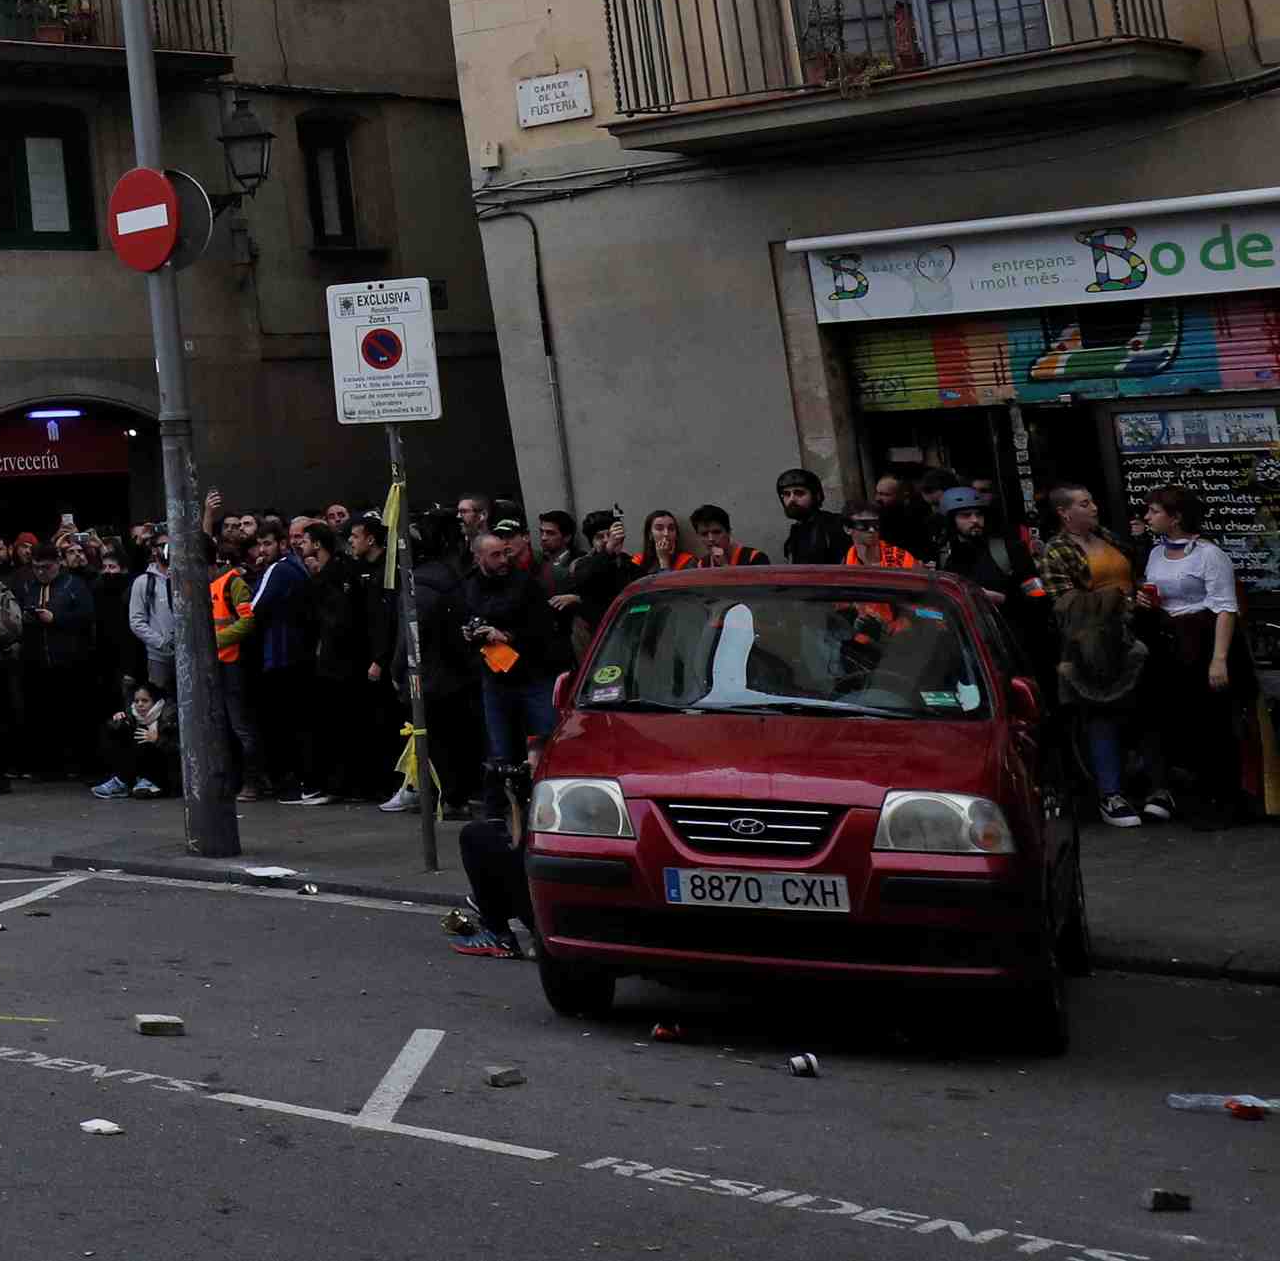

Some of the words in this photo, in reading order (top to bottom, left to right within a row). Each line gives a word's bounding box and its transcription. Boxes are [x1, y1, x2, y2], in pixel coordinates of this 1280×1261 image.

[534, 81, 569, 93] CARRER
[538, 94, 551, 102] DE
[554, 91, 566, 99] LA
[530, 100, 578, 116] FUSTERIA
[991, 254, 1076, 273] entrepans
[980, 274, 1017, 290] molt
[357, 292, 410, 307] EXCLUSIVA
[690, 874, 763, 904] 8870
[781, 878, 841, 907] CXH
[579, 1157, 1162, 1261] RESIDENTS
